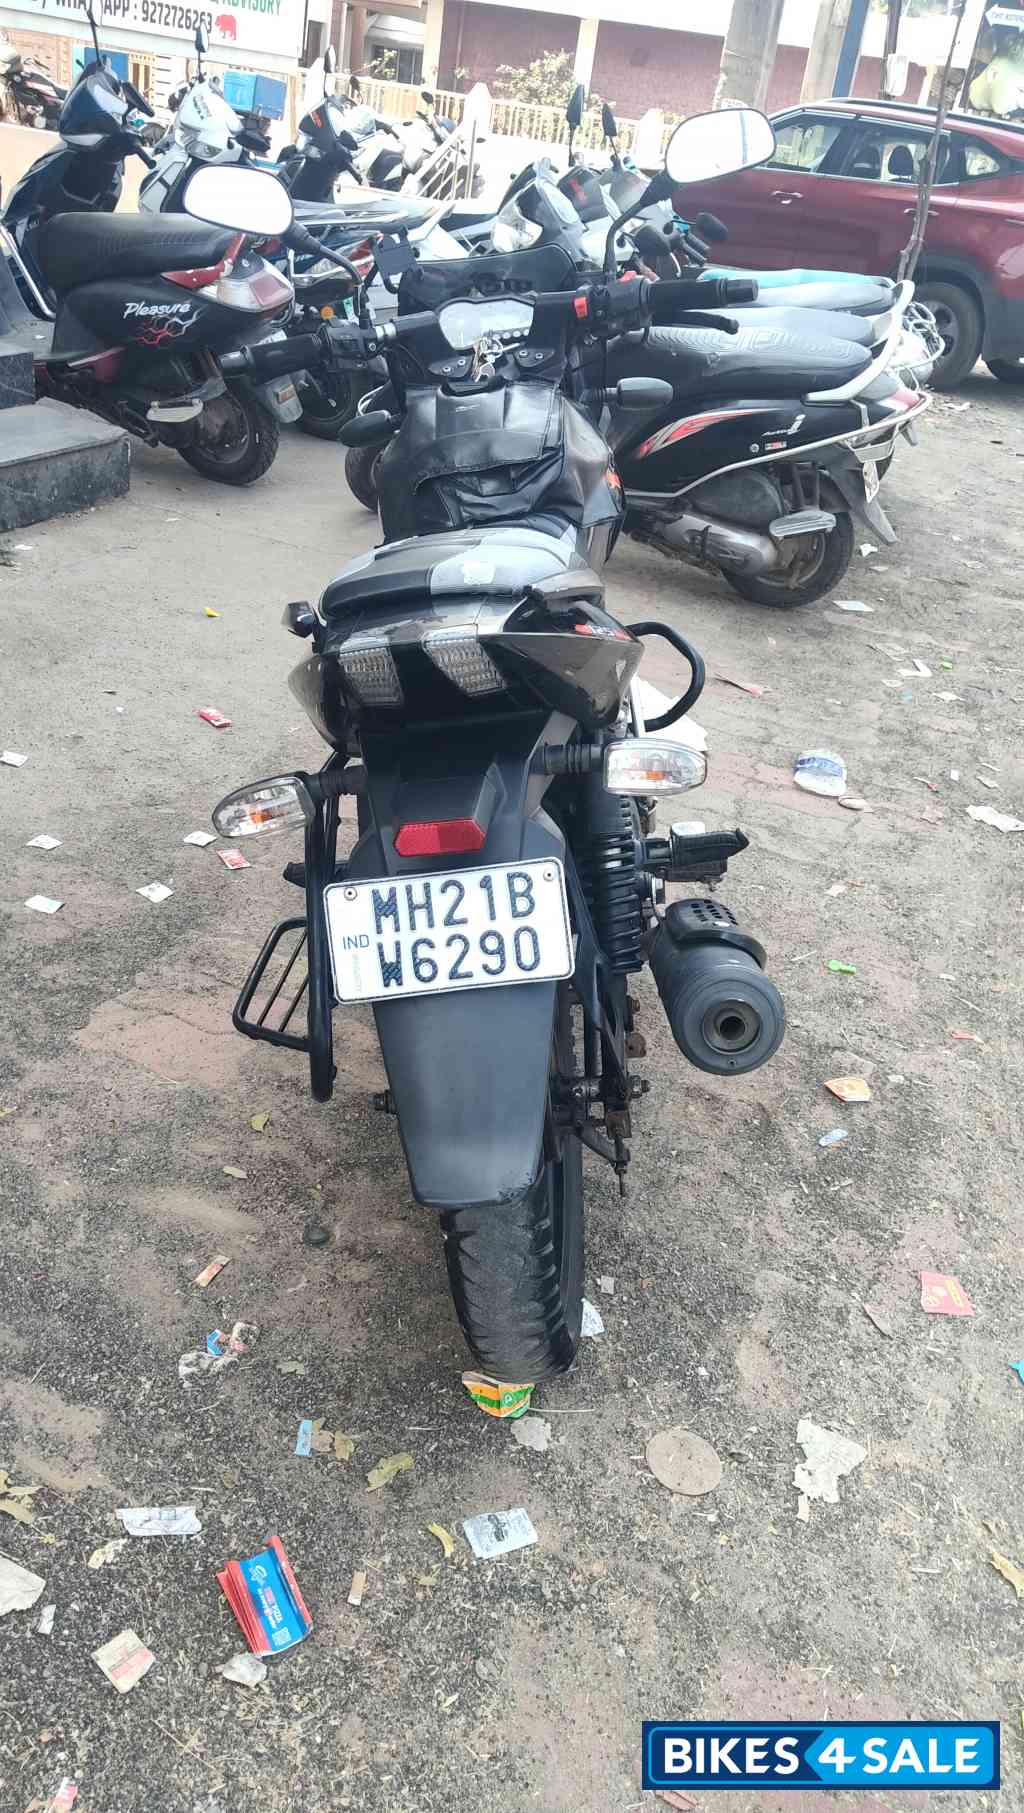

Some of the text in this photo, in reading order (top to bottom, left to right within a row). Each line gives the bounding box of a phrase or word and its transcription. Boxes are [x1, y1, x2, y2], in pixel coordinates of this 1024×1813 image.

[222, 0, 281, 16] ISORY
[123, 301, 192, 319] Pleasure
[371, 871, 536, 935] MH21B
[342, 934, 370, 950] IND
[376, 925, 541, 988] W6290
